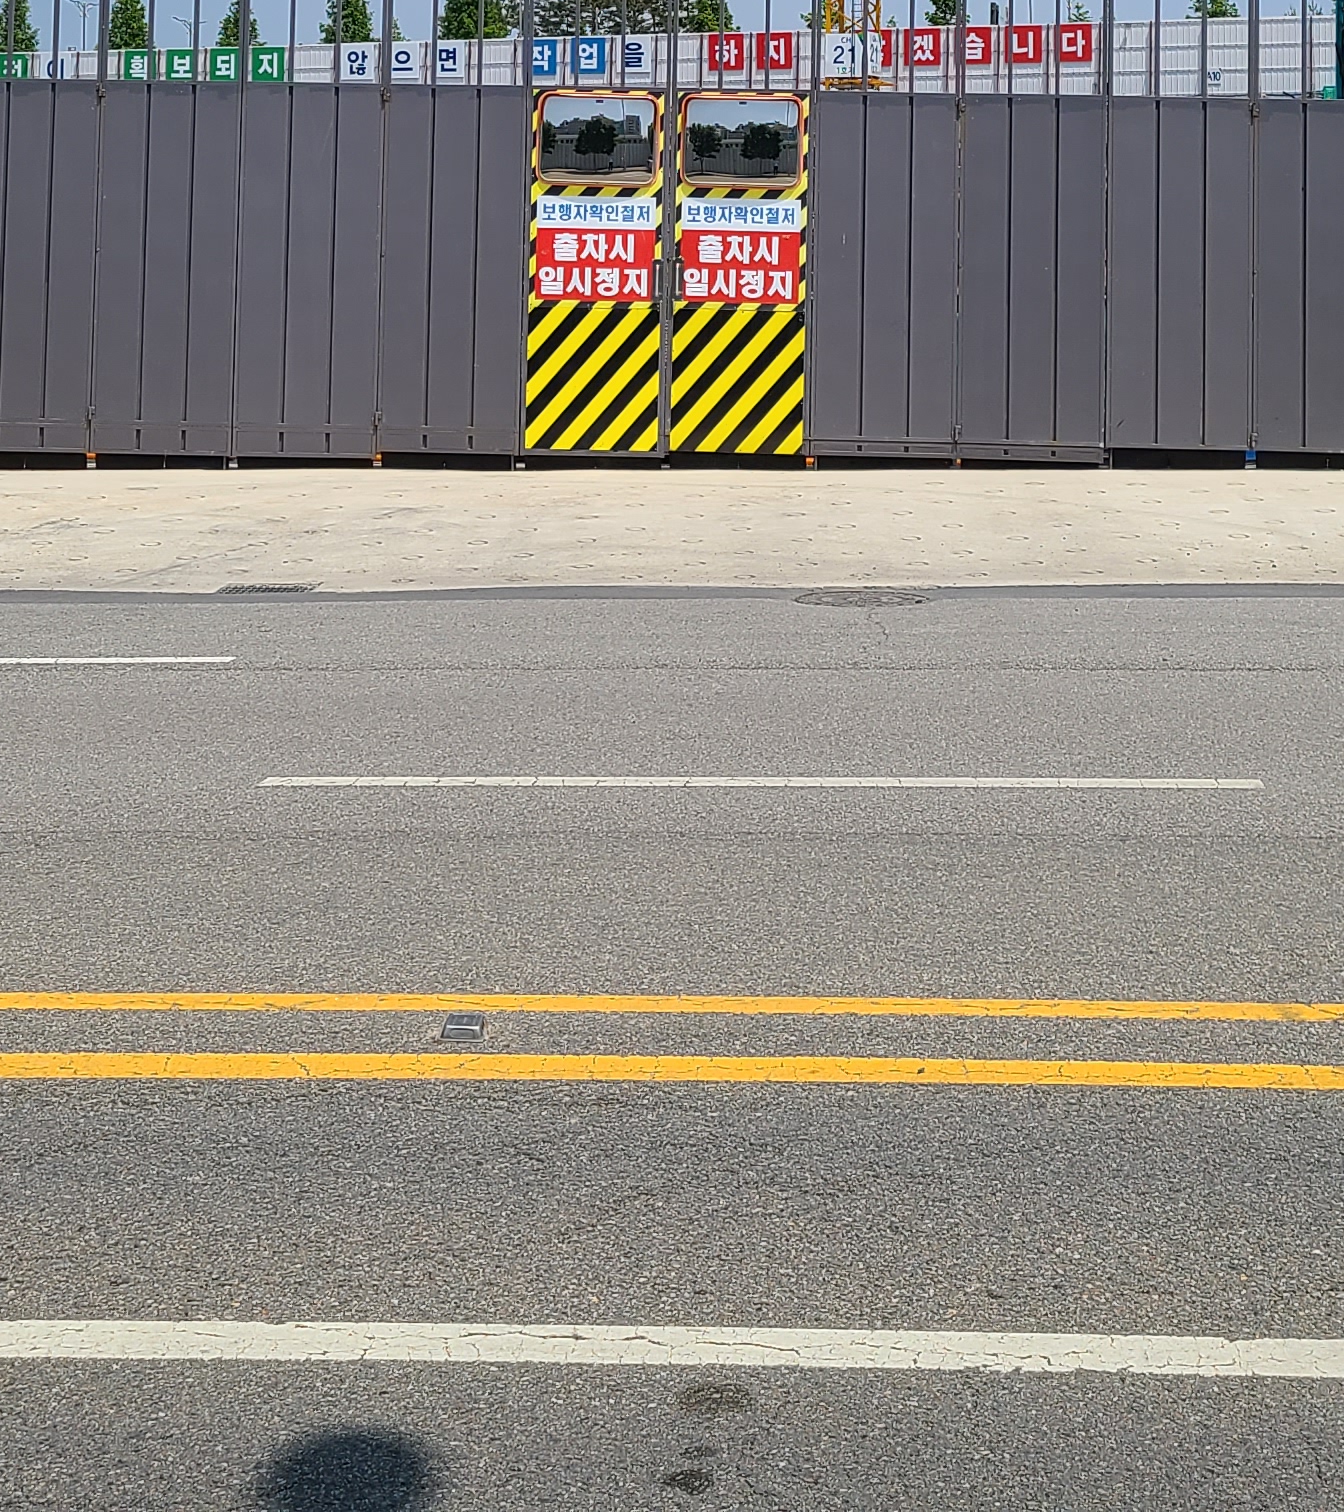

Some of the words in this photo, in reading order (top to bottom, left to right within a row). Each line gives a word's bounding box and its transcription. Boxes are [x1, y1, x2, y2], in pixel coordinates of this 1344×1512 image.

[347, 47, 458, 76] 않으면
[532, 42, 645, 71] 작업을
[715, 38, 785, 67] 하지
[882, 29, 1086, 62] 겠습니다
[552, 232, 636, 263] 출차시
[697, 234, 780, 265] 출차시
[538, 266, 648, 297] 일시정지
[683, 268, 793, 299] 일시정지
